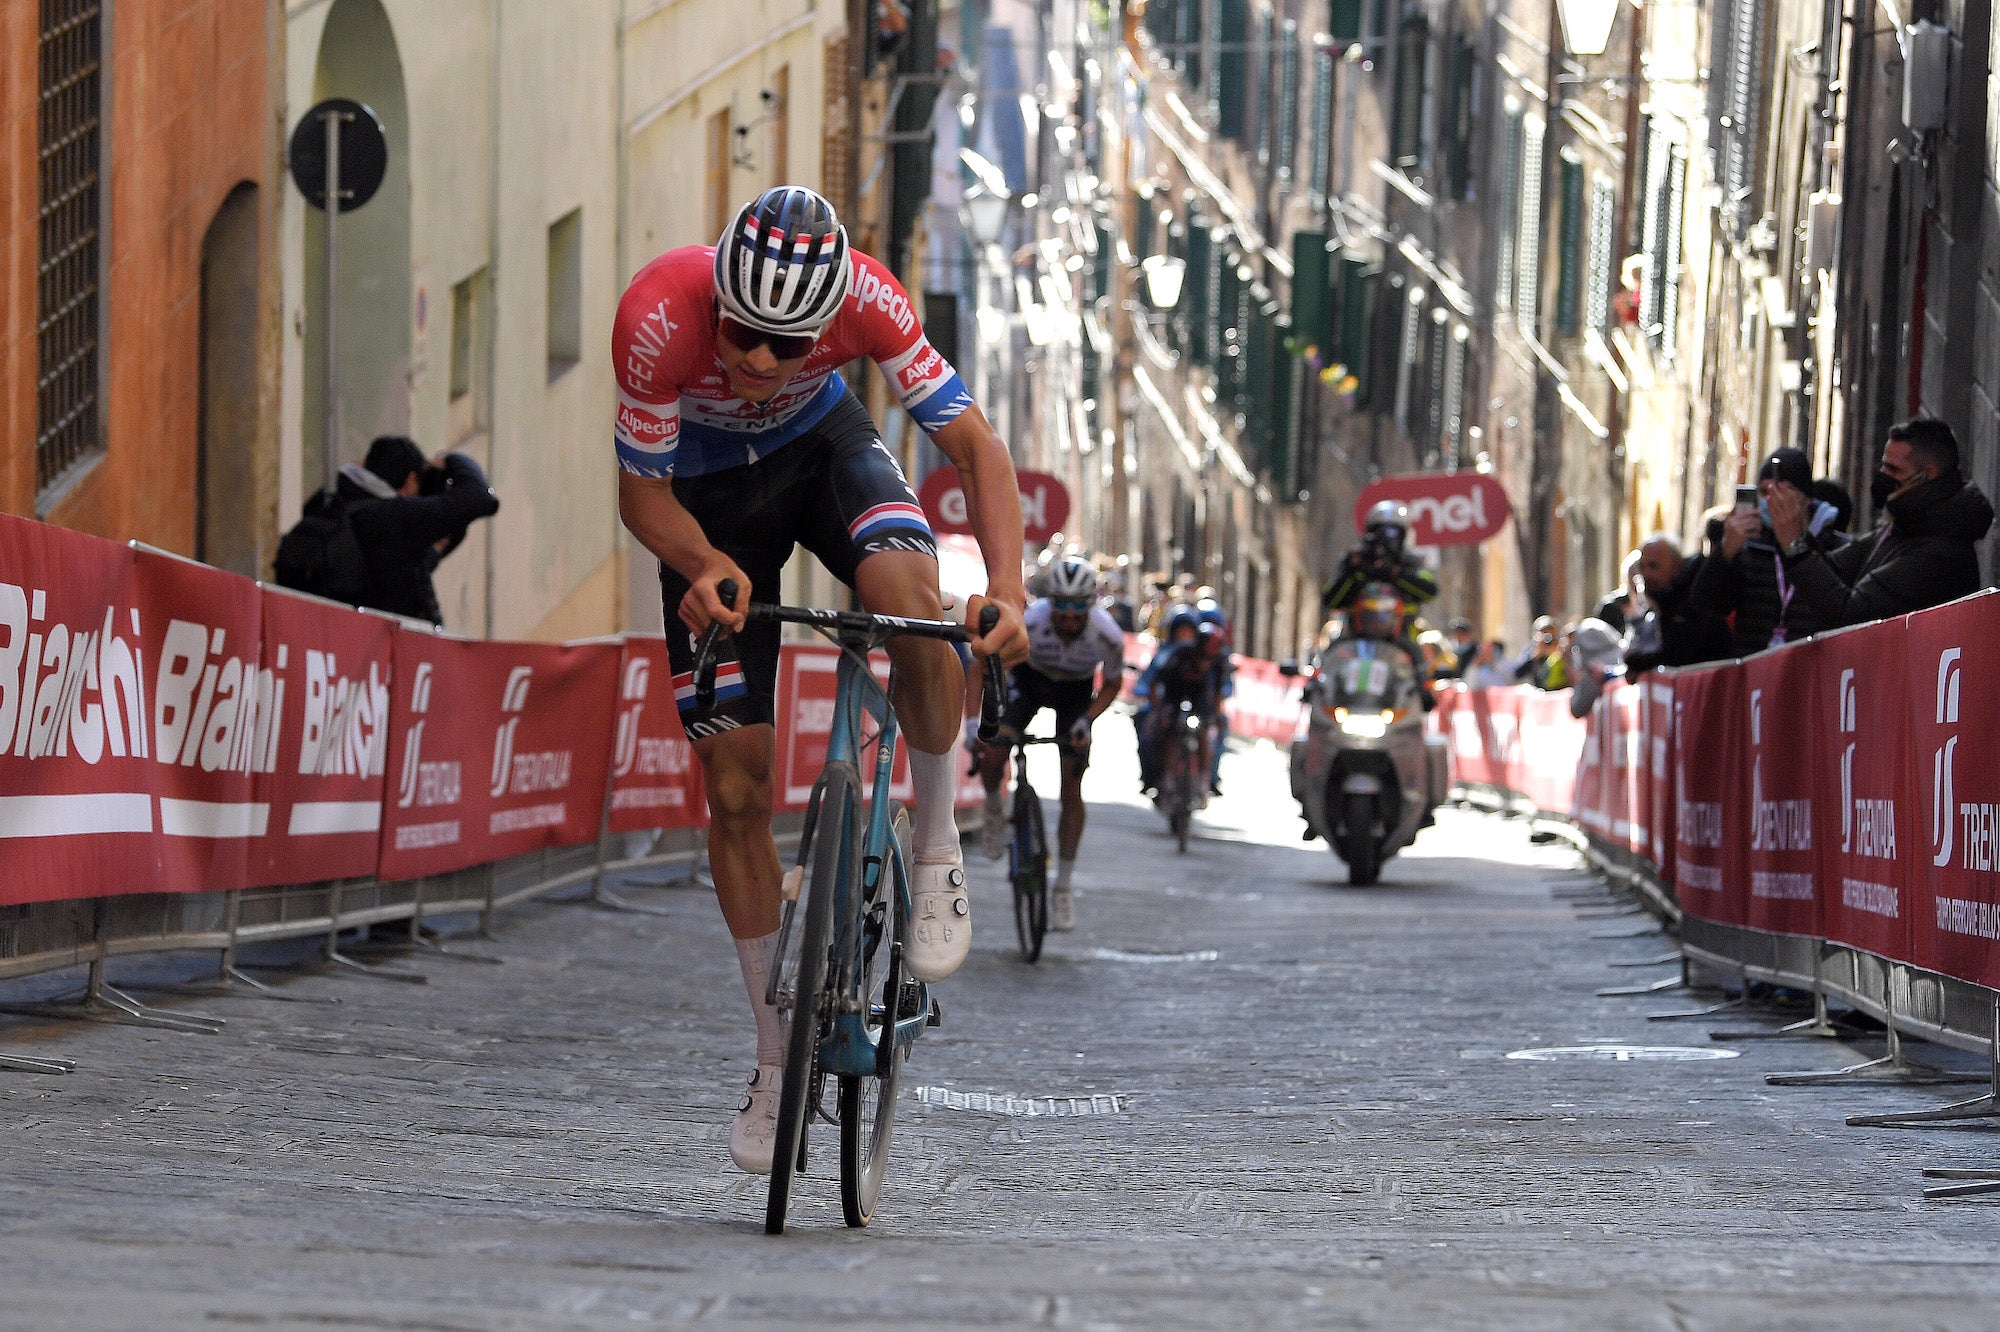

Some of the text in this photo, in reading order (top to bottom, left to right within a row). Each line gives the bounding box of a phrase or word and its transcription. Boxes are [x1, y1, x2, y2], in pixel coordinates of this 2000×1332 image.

[627, 301, 679, 395] FENIX
[905, 347, 945, 385] Alpeci
[620, 407, 677, 435] Alpecin
[938, 484, 1047, 530] eel
[1409, 483, 1489, 534] nel
[155, 618, 289, 778] Biani
[298, 648, 391, 779] Bianch
[1960, 802, 2000, 873] TREN
